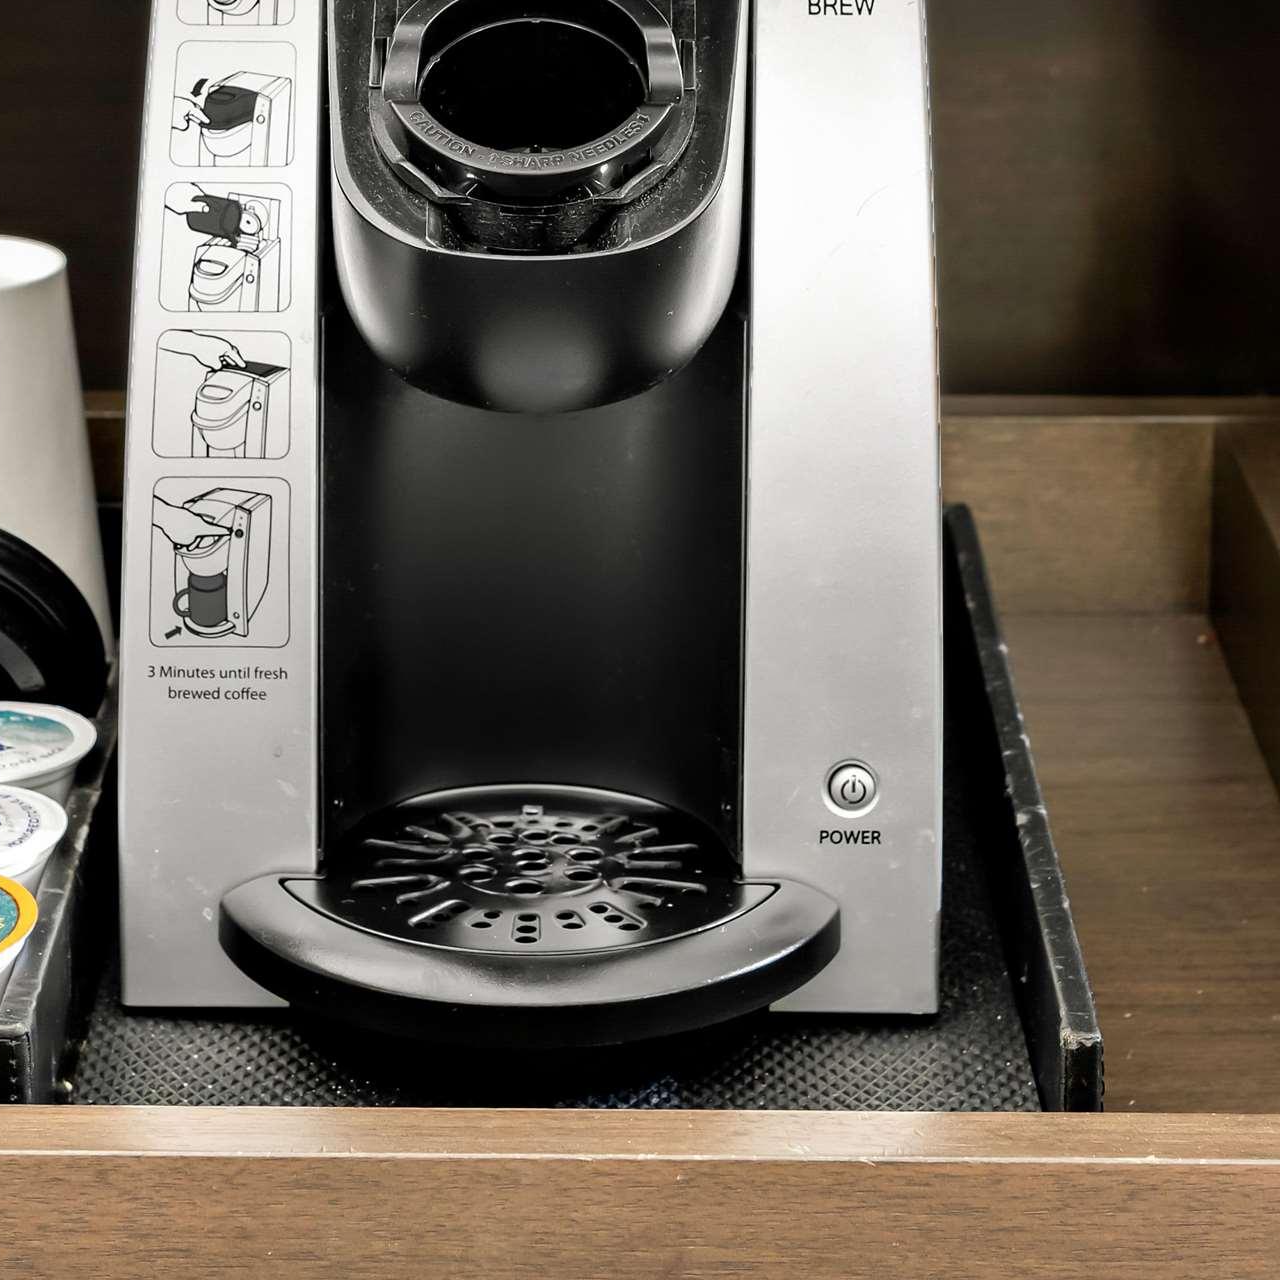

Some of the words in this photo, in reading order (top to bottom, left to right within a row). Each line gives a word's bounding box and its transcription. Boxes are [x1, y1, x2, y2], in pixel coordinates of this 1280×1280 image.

[409, 111, 476, 155] CAUTION
[501, 153, 565, 169] SHARP
[147, 665, 156, 678] 3
[159, 665, 216, 679] Minutes
[219, 666, 250, 680] until
[254, 666, 288, 680] fresh
[168, 686, 220, 700] brewed
[224, 687, 267, 701] coffee
[819, 830, 881, 844] POWER
